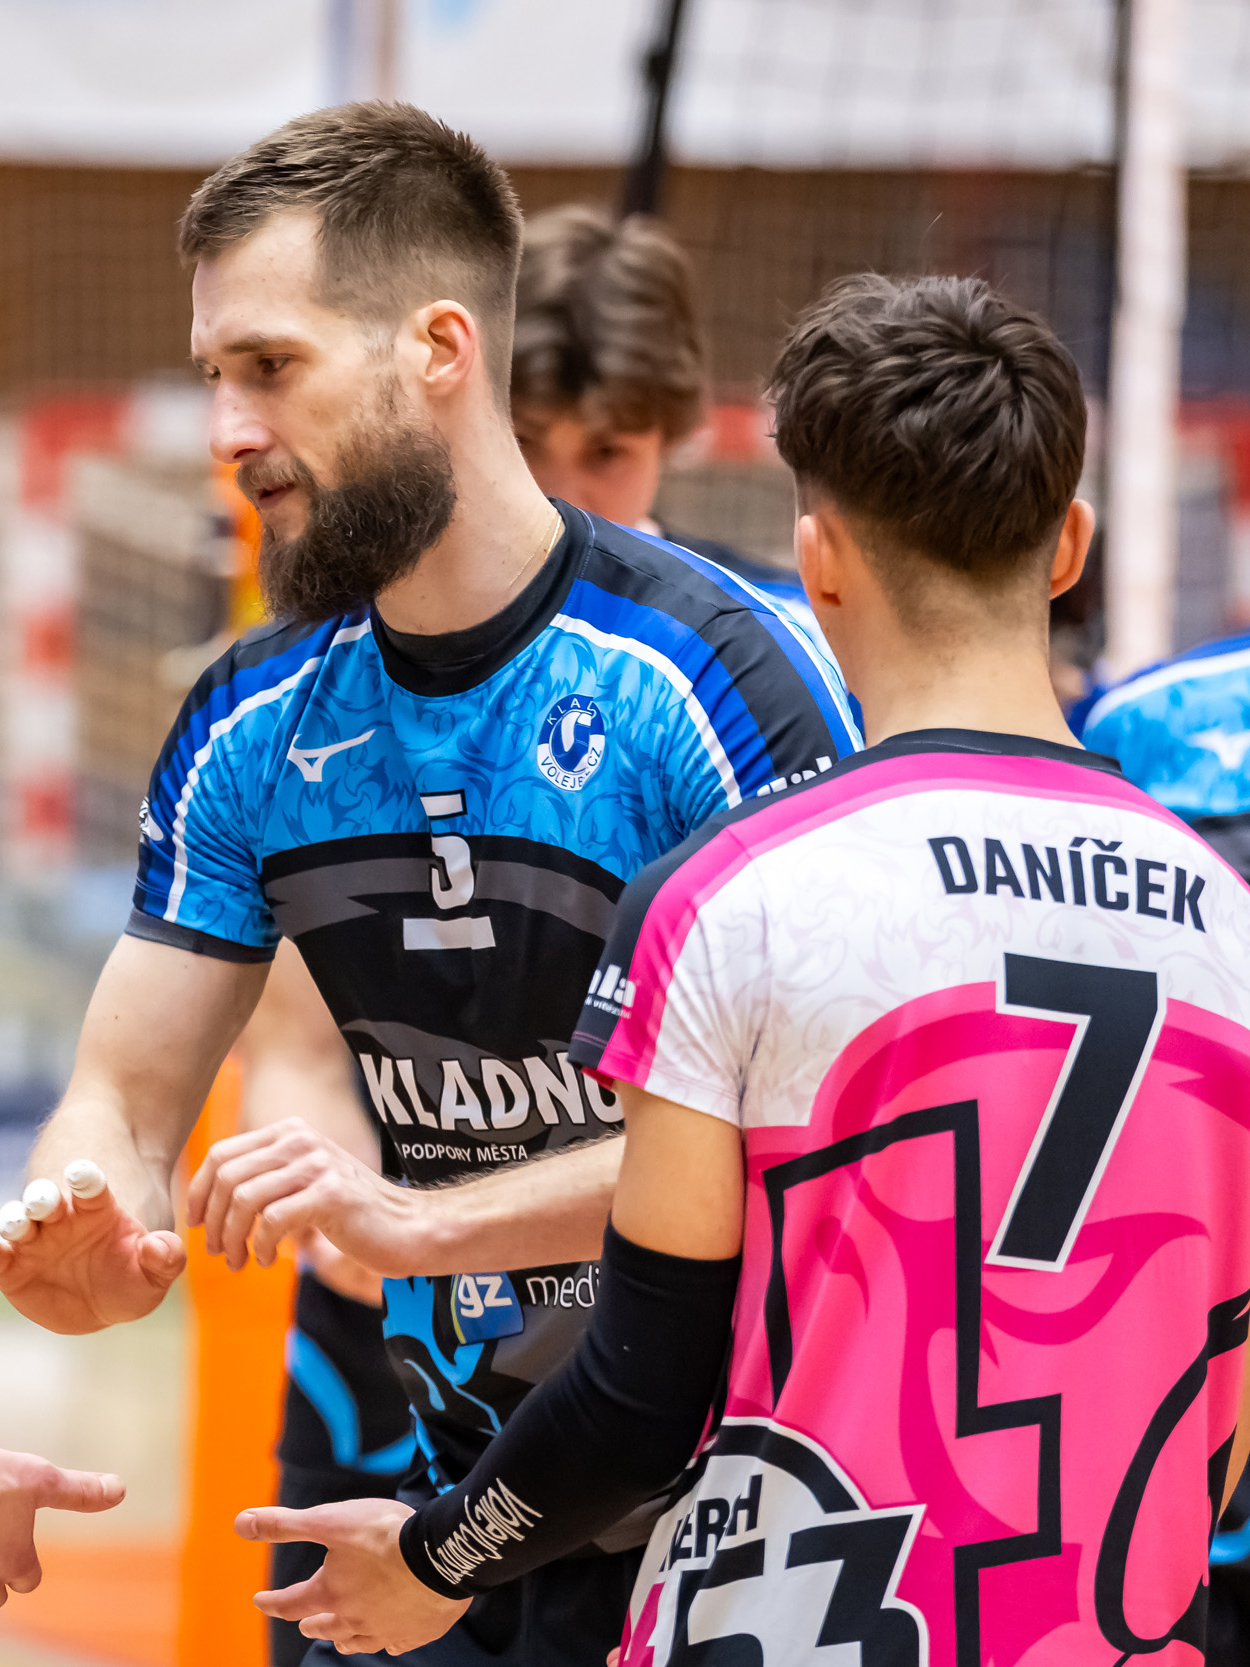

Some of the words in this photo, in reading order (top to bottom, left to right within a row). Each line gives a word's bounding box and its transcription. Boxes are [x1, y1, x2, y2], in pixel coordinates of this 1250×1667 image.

[420, 793, 475, 910] 5
[928, 836, 1206, 932] DANÍČEK
[401, 1143, 472, 1162] PODPORY
[476, 1143, 528, 1162] MĚSTA
[990, 952, 1160, 1268] 7
[458, 1274, 513, 1318] gz
